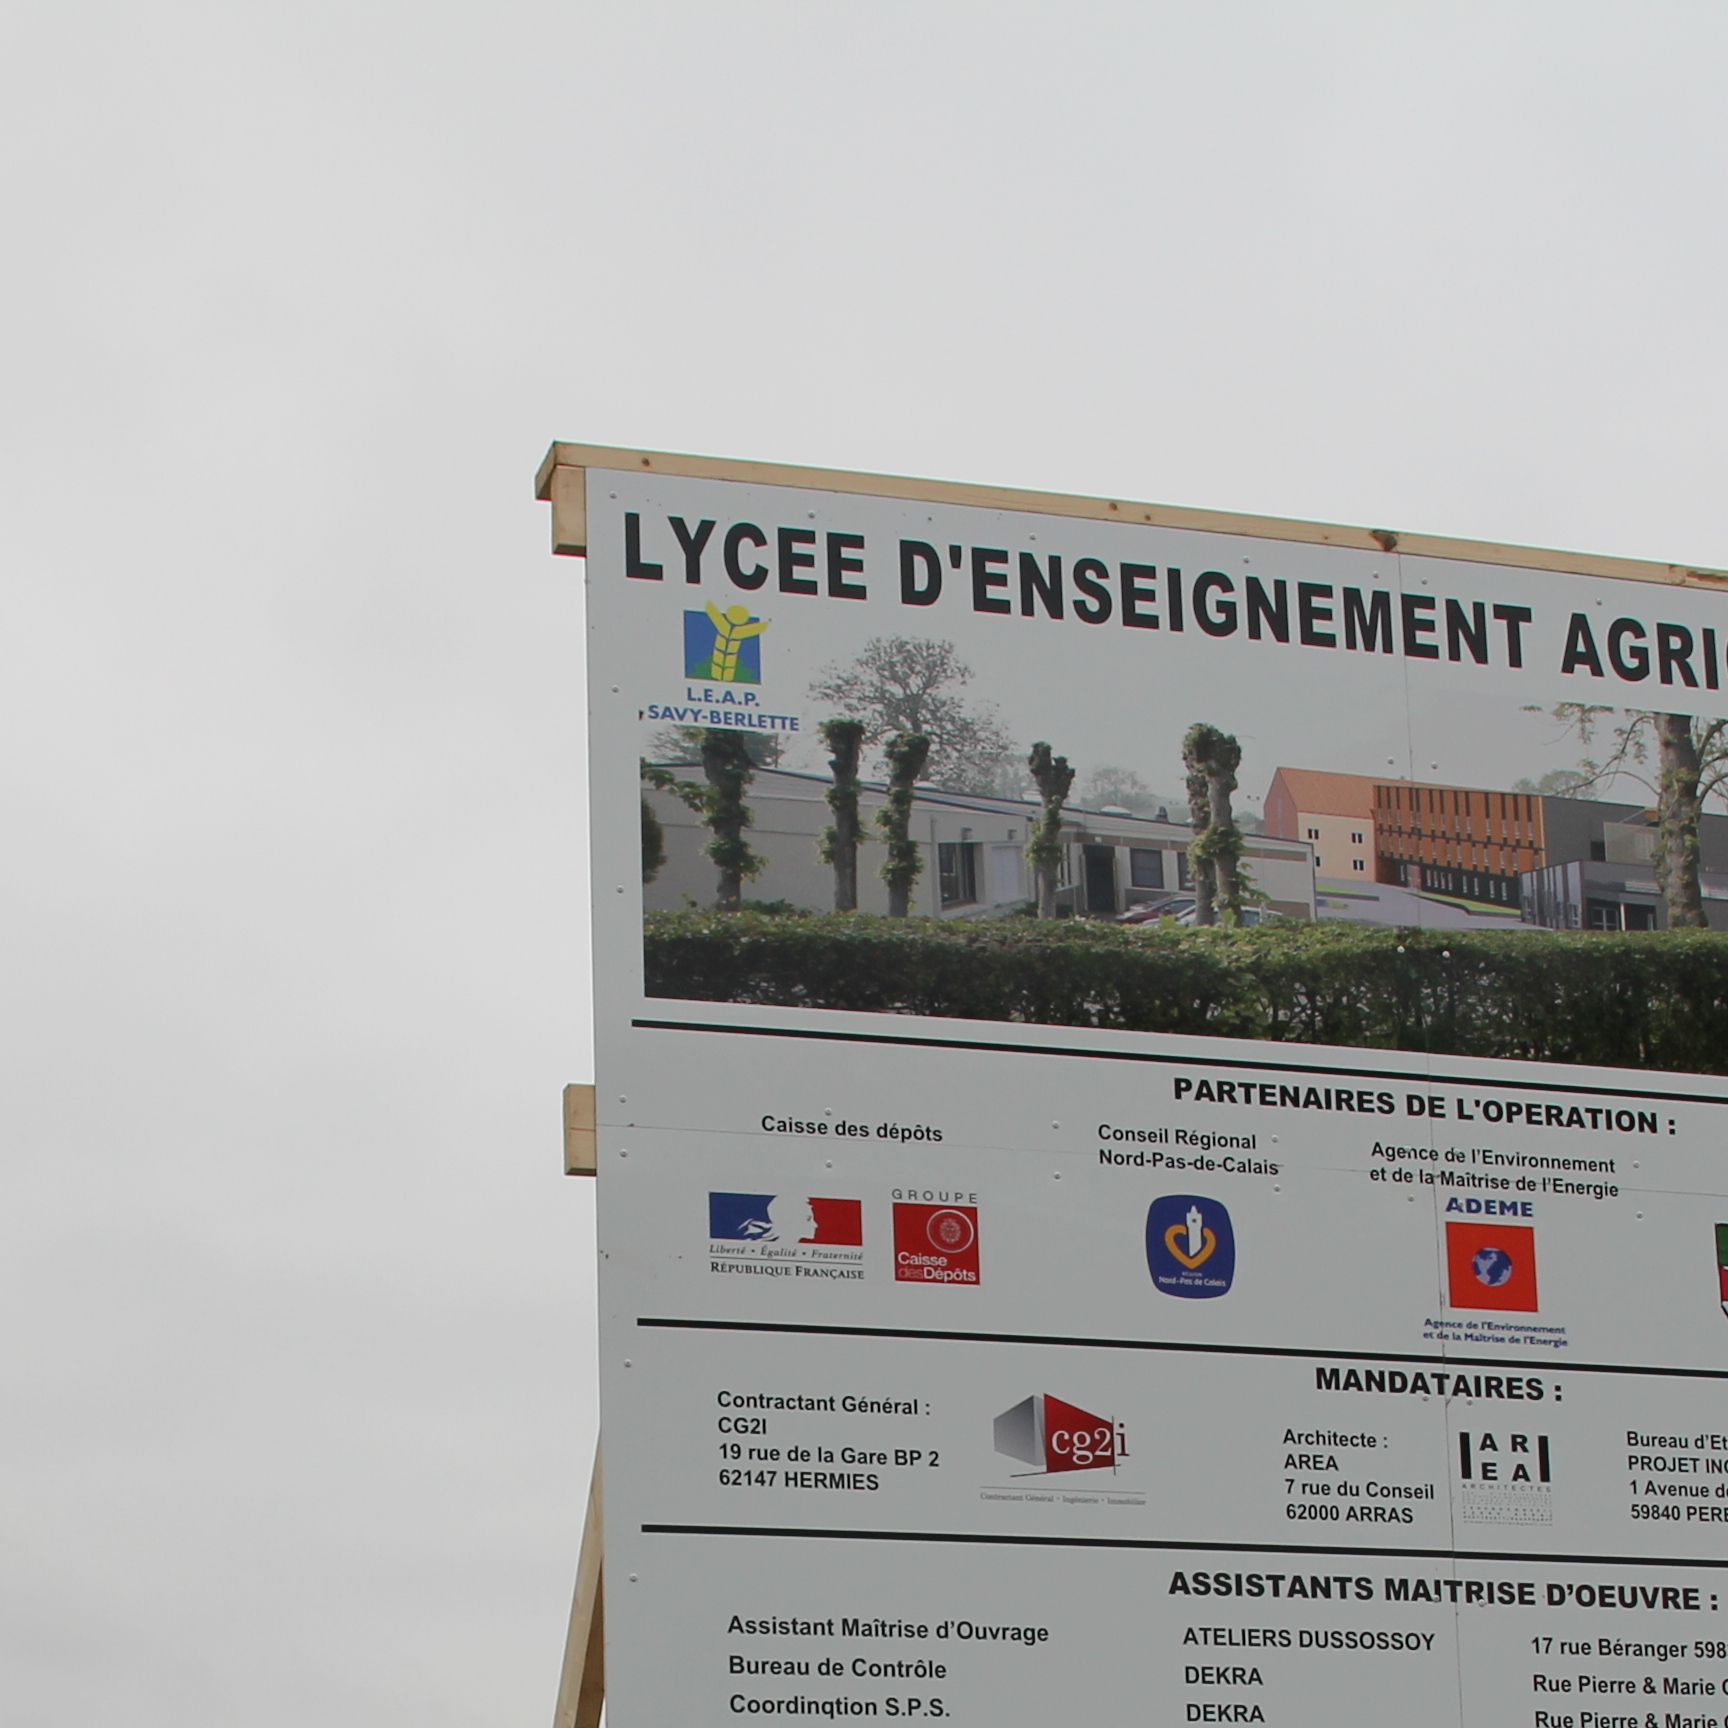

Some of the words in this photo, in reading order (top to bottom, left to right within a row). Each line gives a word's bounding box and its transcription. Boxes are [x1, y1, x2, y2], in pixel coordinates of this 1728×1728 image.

[624, 511, 868, 601] LYCEE
[898, 538, 1533, 669] D'ENSEIGNEMENT
[686, 686, 760, 707] L.E.A.P.
[648, 703, 801, 732] SAVY-BERLETTE
[1173, 1077, 1396, 1115] PARTENAIRES
[1406, 1093, 1447, 1119] DE
[1456, 1097, 1658, 1134] L'OPERATION
[761, 1115, 828, 1135] Caisse
[834, 1120, 870, 1138] des
[876, 1122, 943, 1144] dépôts
[1098, 1124, 1169, 1144] Conseil
[1175, 1128, 1256, 1151] Régional
[1099, 1148, 1279, 1176] Nord-Pas-de-Calais
[1371, 1141, 1439, 1162] Agence
[1444, 1147, 1466, 1164] de
[1471, 1148, 1616, 1174] l'Environnement
[891, 1188, 977, 1204] GROUPE
[1445, 1197, 1534, 1218] ADEME
[709, 1244, 746, 1255] Liberté
[759, 1245, 797, 1258] Égalité
[811, 1250, 864, 1261] Fraternité
[897, 1251, 948, 1266] Caisse
[710, 1261, 792, 1278] RÉPUBLIQUE
[795, 1265, 865, 1280] FRANÇAISE
[1424, 1318, 1463, 1330] Agence
[1465, 1321, 1479, 1330] de
[718, 1416, 767, 1435] CG2I
[1050, 1422, 1131, 1465] cg2i
[1284, 1453, 1339, 1472] AREA
[1628, 1454, 1701, 1474] PROJET
[719, 1468, 778, 1487] 62147
[784, 1470, 879, 1491] HERMIES
[1461, 1483, 1552, 1493] ARCHITECTES
[1286, 1503, 1340, 1521] 62000
[1345, 1505, 1414, 1524] ARRAS
[1631, 1503, 1681, 1521] 59840
[1182, 1626, 1292, 1648] ATELIERS
[1298, 1629, 1435, 1651] DUSSOSSOY
[729, 1655, 810, 1676] Bureau
[817, 1657, 844, 1677] de
[851, 1657, 947, 1679] Contrôle
[1184, 1665, 1264, 1686] DEKRA
[729, 1694, 878, 1720] Coordinqtion
[885, 1697, 950, 1718] S.P.S.
[1186, 1703, 1266, 1723] DEKRA
